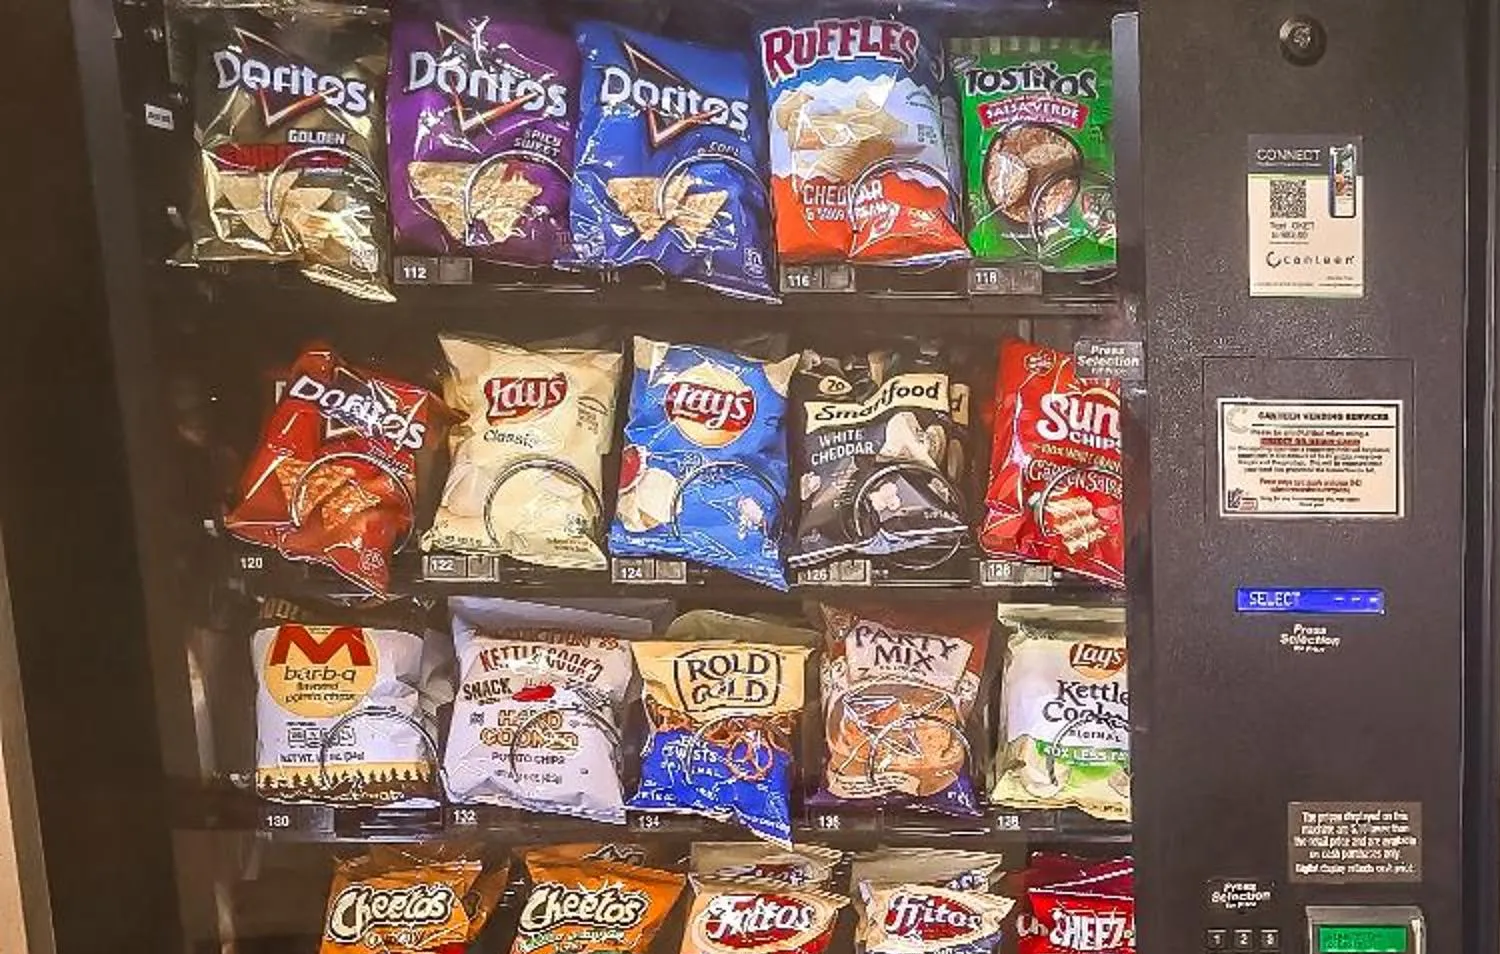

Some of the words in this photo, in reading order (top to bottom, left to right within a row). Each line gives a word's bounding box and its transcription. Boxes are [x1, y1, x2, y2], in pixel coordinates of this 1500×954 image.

[760, 18, 919, 84] RUFFLES
[214, 50, 366, 113] Doritos
[408, 50, 567, 117] Doritos
[964, 66, 1097, 98] TOSTITOS
[601, 67, 750, 131] Doritos
[288, 129, 346, 145] GOLDEN
[1257, 149, 1321, 161] CONNECT
[404, 266, 426, 280] 112
[288, 375, 427, 450] Doritos
[812, 381, 943, 424] Smartfood
[818, 430, 865, 448] WHITE
[810, 440, 877, 466] CHEDDAR
[240, 557, 263, 569] 120
[430, 560, 454, 571] 122
[620, 567, 643, 579] 124
[1249, 591, 1300, 607] SELECT
[855, 626, 958, 660] PARTY
[686, 653, 770, 682] ROLD
[874, 645, 935, 676] MIX
[284, 666, 356, 683] bar-b-q
[463, 678, 512, 700] SNACK
[267, 816, 289, 827] 130
[454, 811, 476, 822] 132
[638, 815, 660, 828] 134
[327, 885, 454, 941] Cheetos
[518, 884, 649, 934] Cheetos
[705, 894, 815, 939] Fritos
